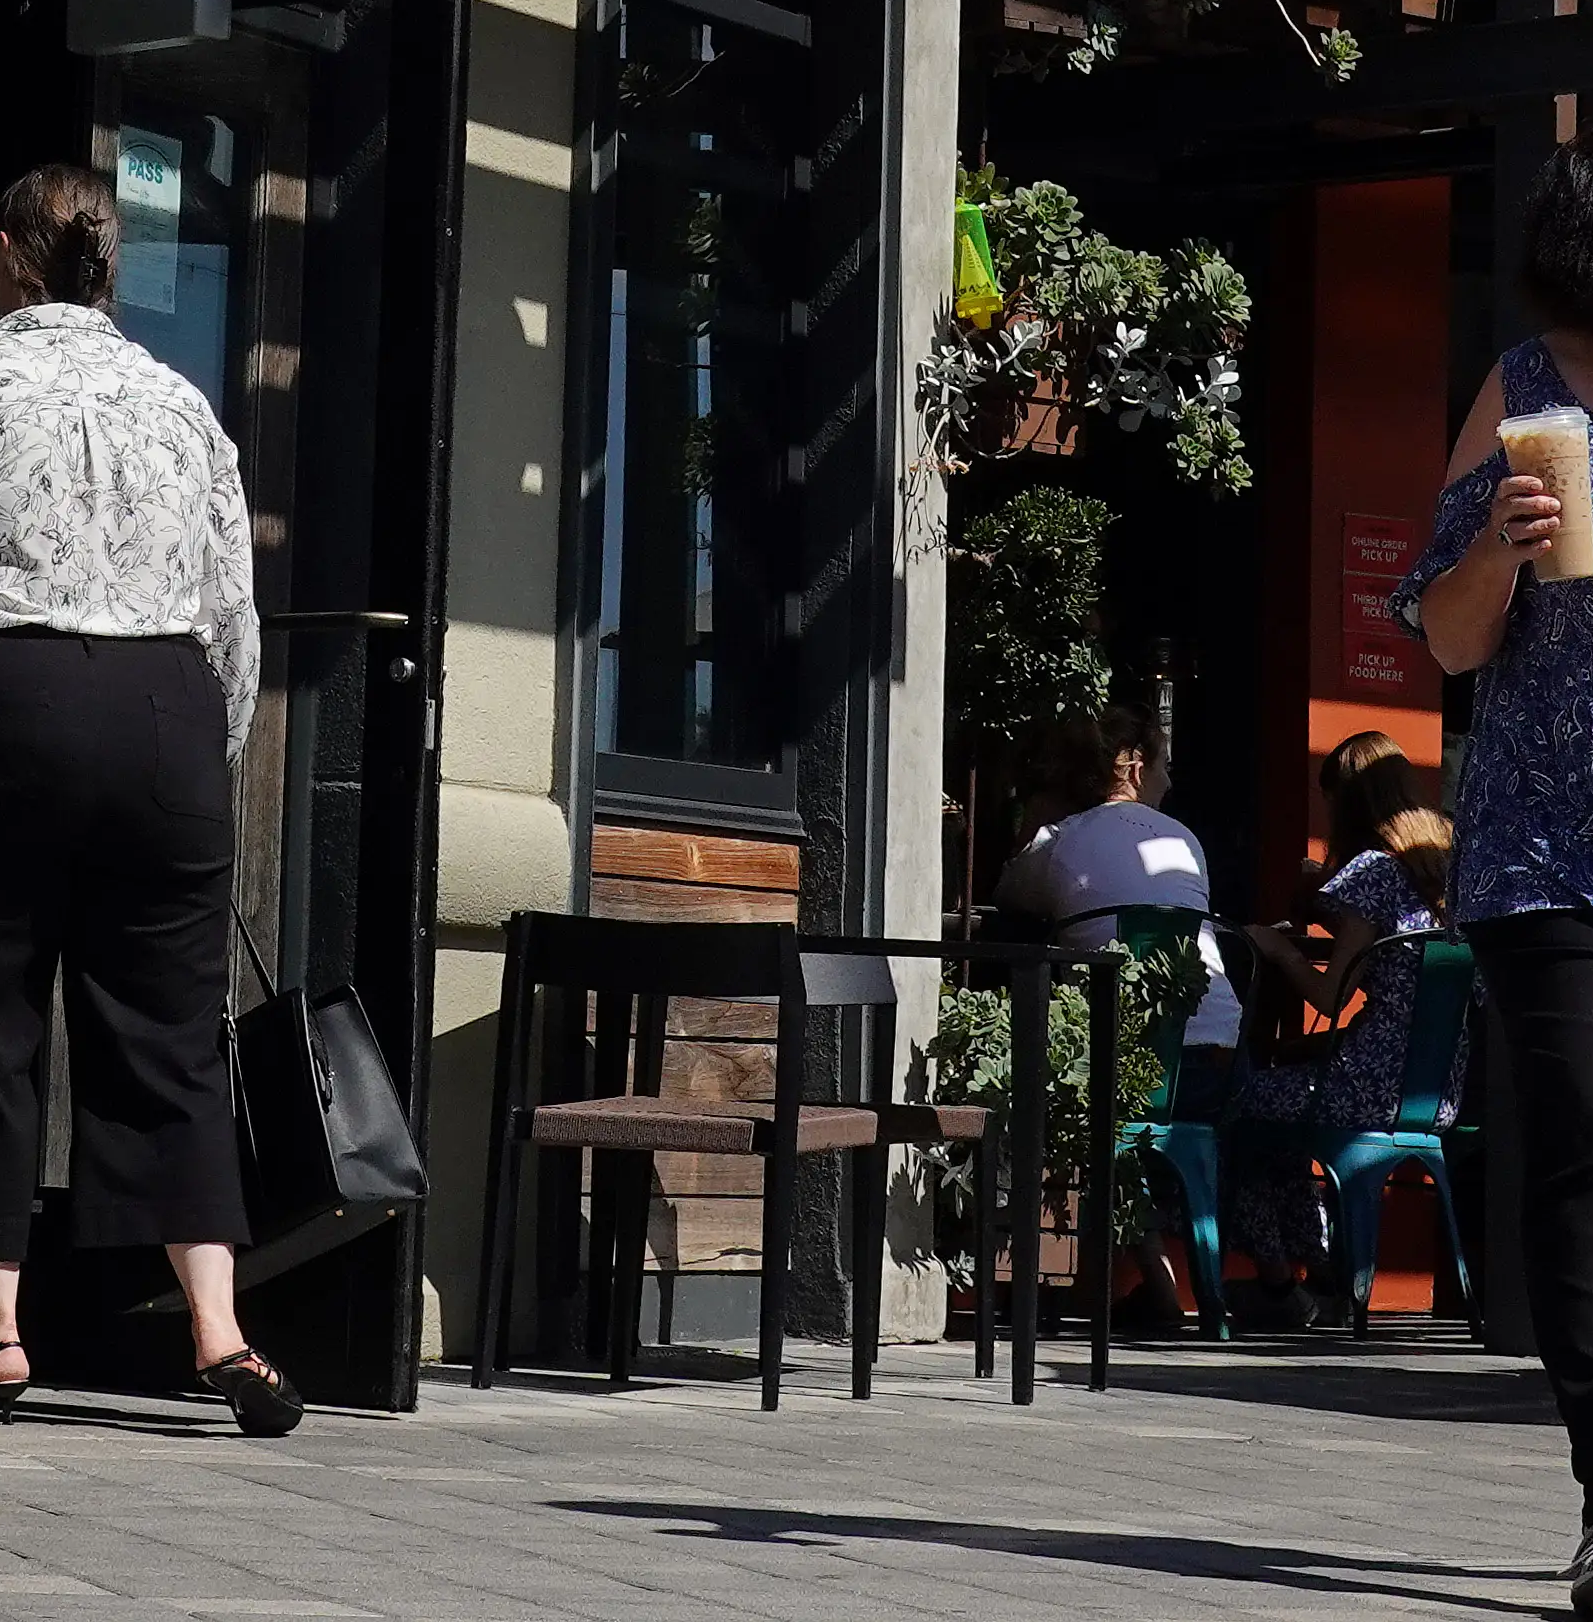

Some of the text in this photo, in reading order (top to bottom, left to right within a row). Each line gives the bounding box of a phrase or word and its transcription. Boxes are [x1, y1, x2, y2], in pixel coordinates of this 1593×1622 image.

[128, 157, 163, 183] PASS
[1351, 536, 1408, 552] ONLINE ORDER
[1361, 549, 1399, 564] PICK UP
[1352, 593, 1379, 605] THIRD
[1362, 606, 1382, 618] PICK
[1358, 653, 1396, 666] PICK UP
[1349, 666, 1404, 683] FOOD HERE
